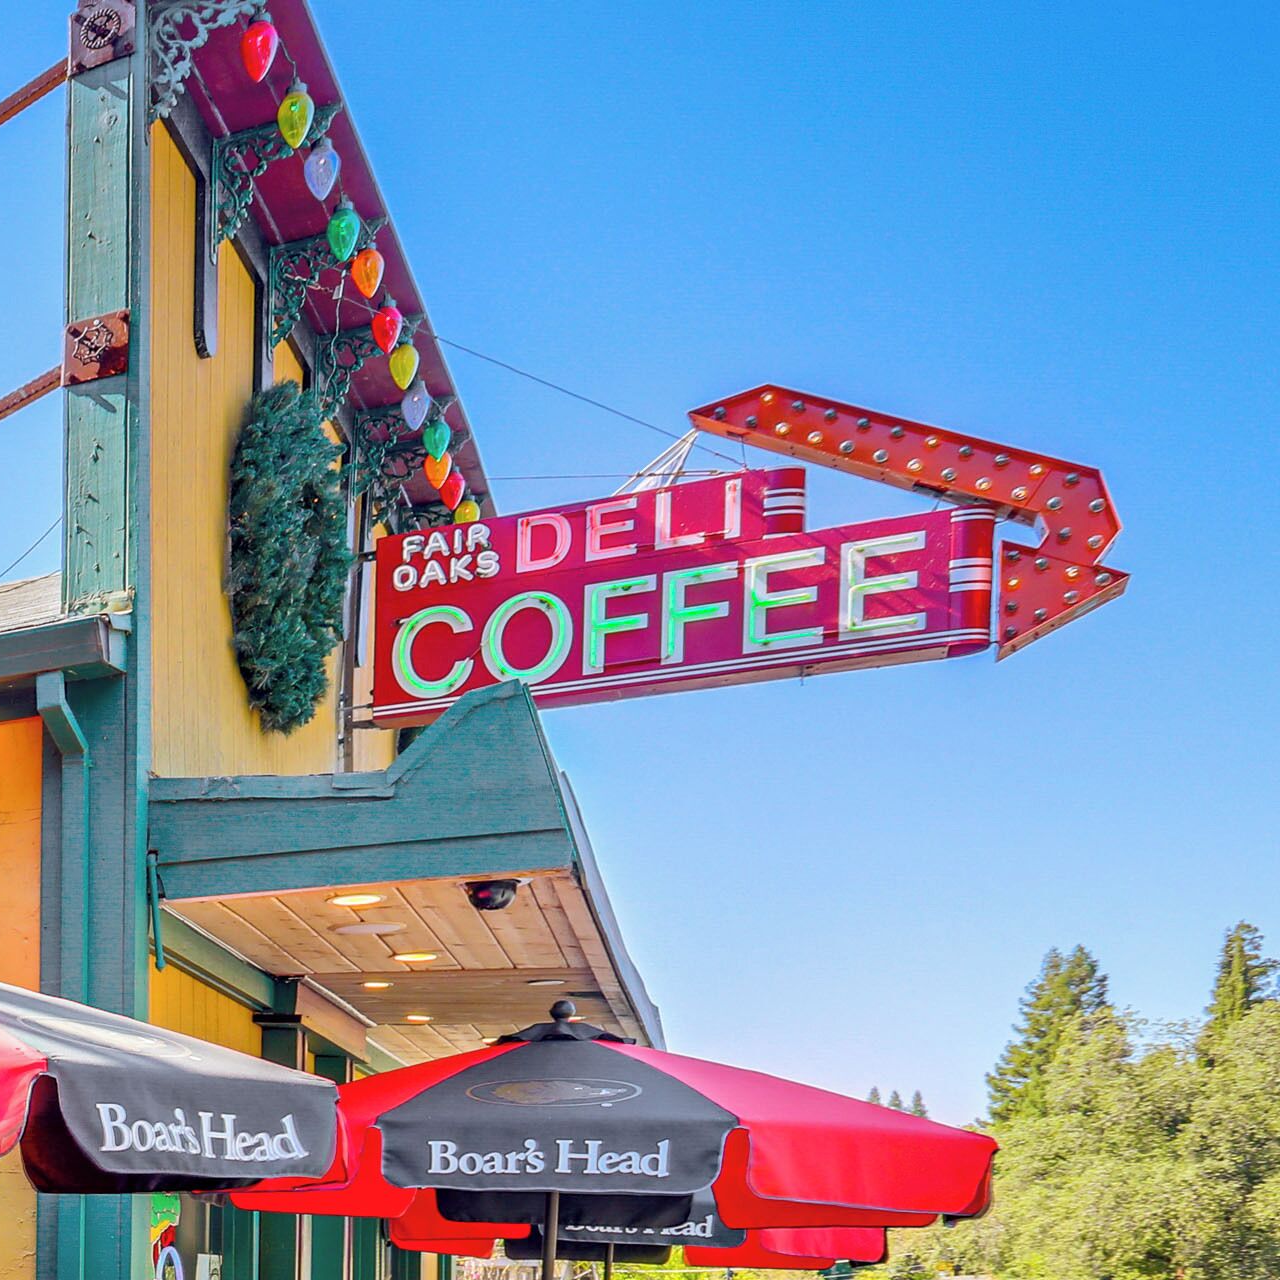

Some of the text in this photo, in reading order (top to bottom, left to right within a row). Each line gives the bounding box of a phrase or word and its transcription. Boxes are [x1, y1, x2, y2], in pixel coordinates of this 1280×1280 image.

[402, 523, 492, 563] FAIR
[516, 479, 741, 573] DELI
[392, 550, 500, 592] OAKS
[392, 530, 927, 699] COFFEE
[95, 1103, 310, 1161] Boar's Head
[427, 1139, 671, 1179] Boar's Head
